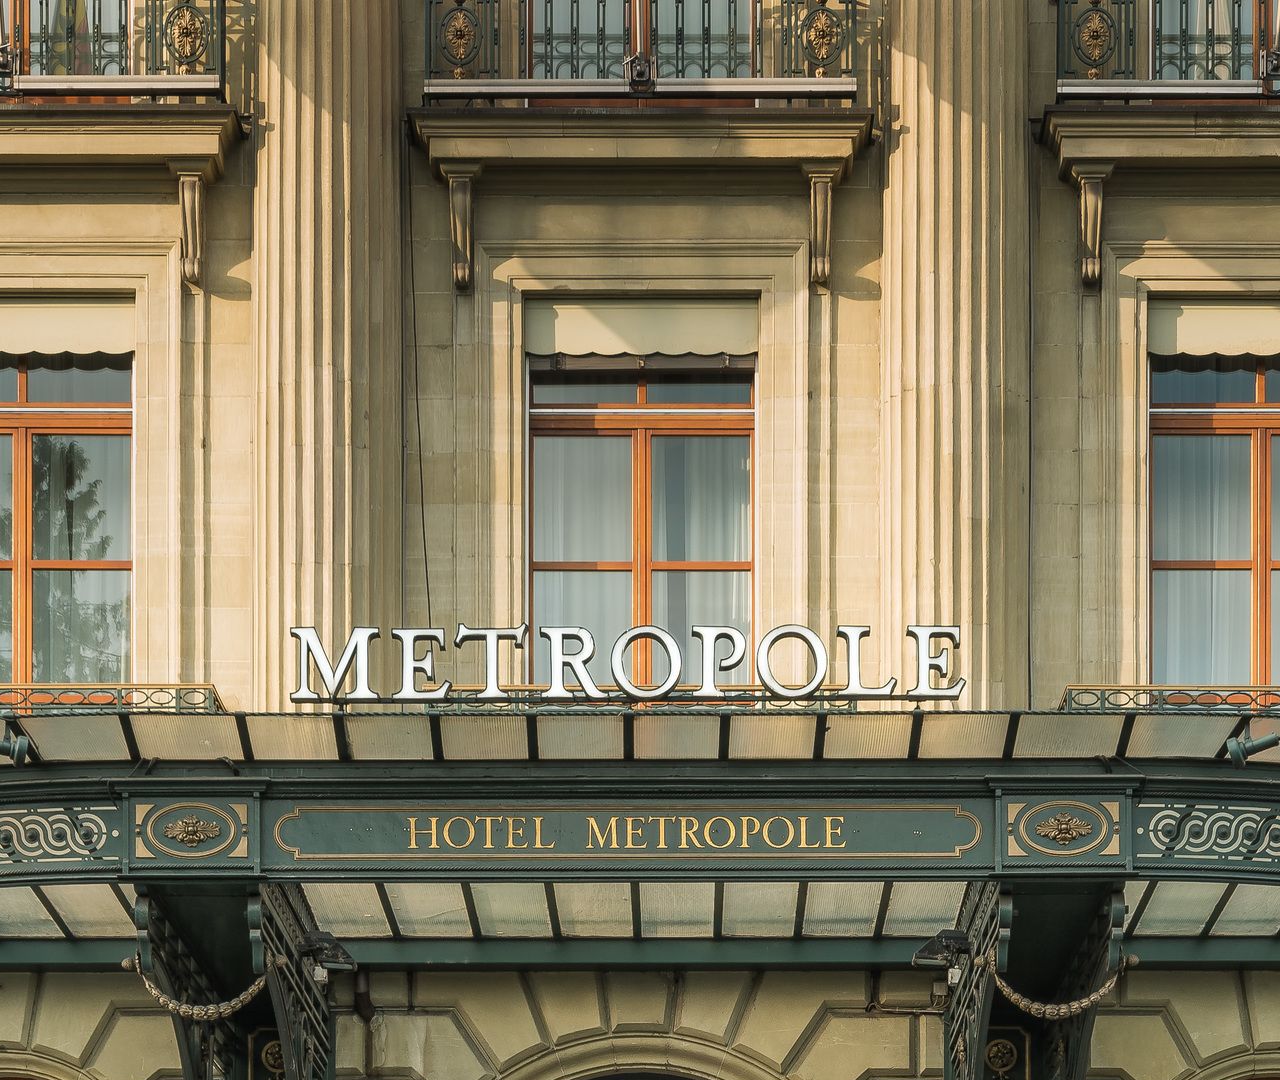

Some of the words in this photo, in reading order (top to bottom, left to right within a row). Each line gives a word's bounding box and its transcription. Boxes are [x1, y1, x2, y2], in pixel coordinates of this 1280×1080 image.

[290, 622, 965, 702] METROPOLE
[407, 816, 555, 850] HOTEL
[586, 816, 847, 850] METROPOLE
